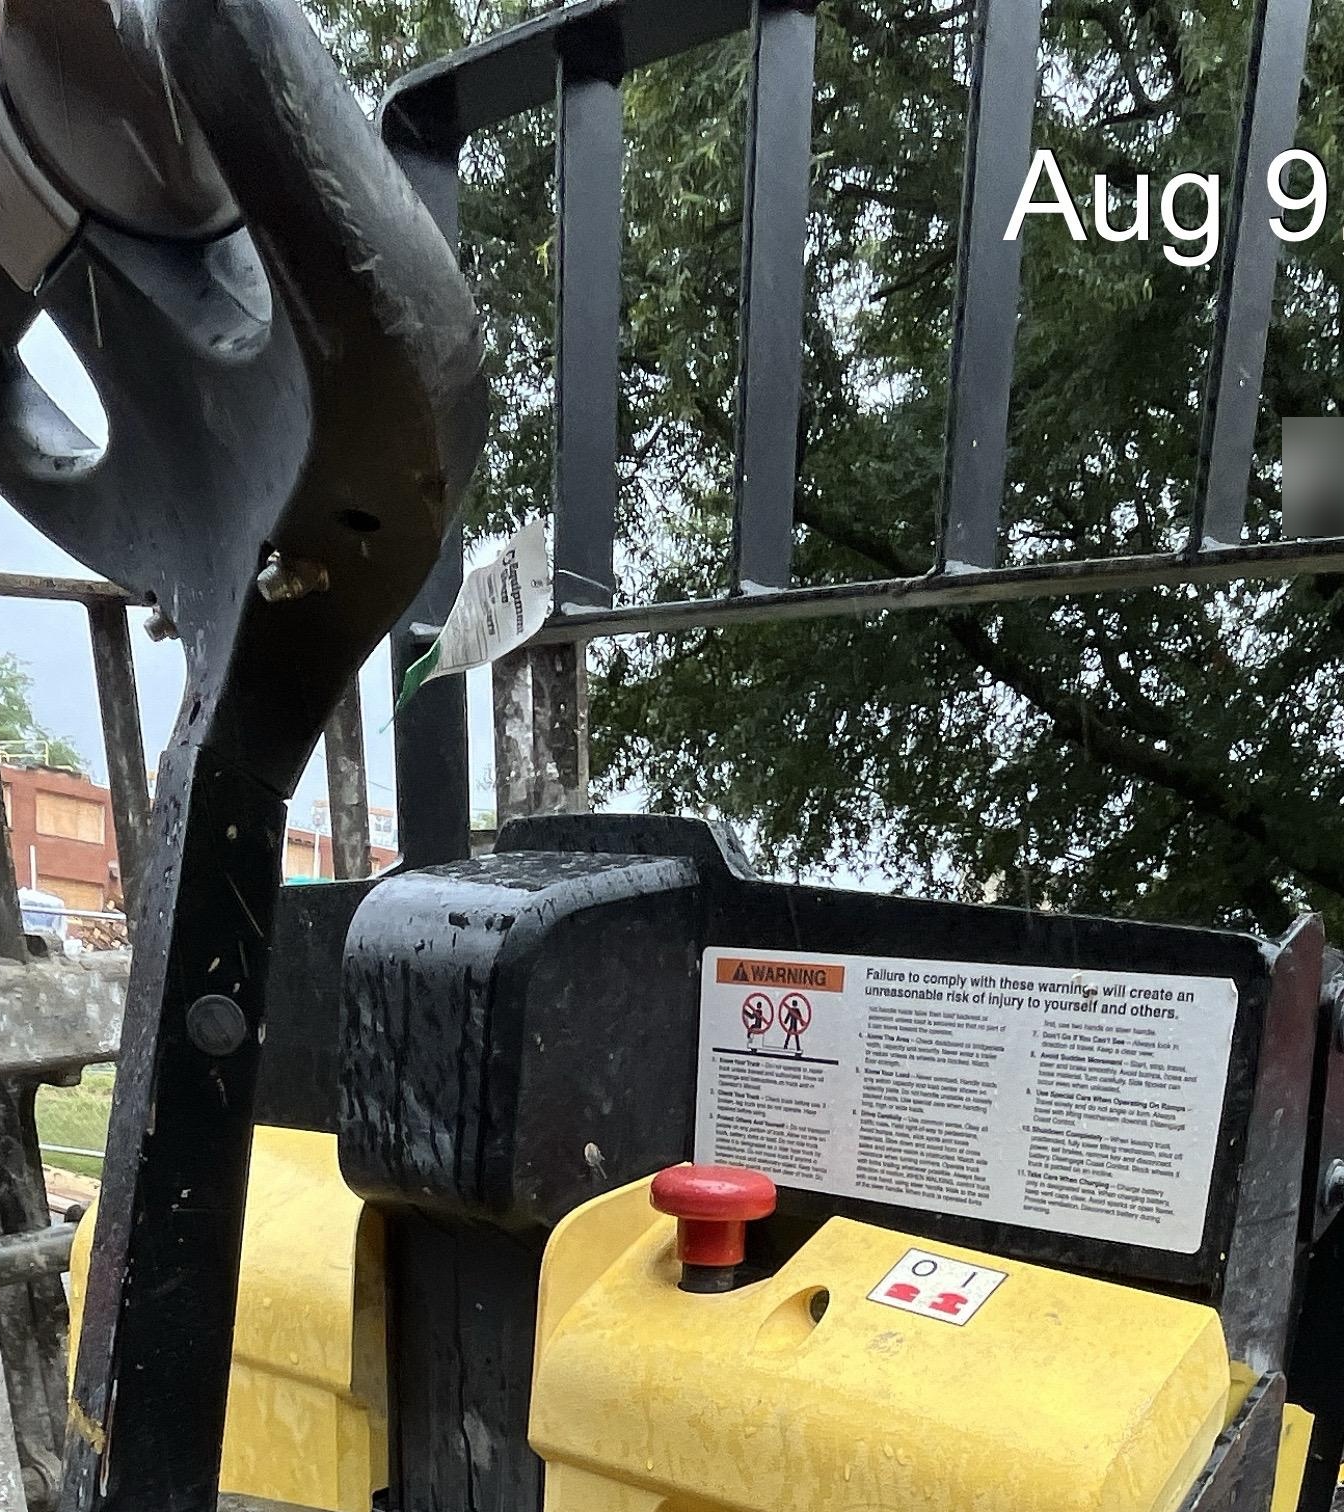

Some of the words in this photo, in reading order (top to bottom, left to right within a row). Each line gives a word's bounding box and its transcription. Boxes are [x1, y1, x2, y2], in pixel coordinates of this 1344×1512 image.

[751, 965, 826, 986] WARNING
[866, 968, 905, 982] Failure
[909, 971, 920, 982] to
[923, 973, 968, 989] comply
[970, 976, 996, 989] with
[1000, 978, 1034, 991] these
[1038, 981, 1099, 999] warnings
[1102, 984, 1126, 998] will
[1129, 986, 1173, 1001] create
[1177, 990, 1195, 1003] an
[865, 986, 943, 1001] unreasonable
[946, 990, 969, 1004] risk
[972, 992, 985, 1005] of
[988, 993, 1024, 1011] injury
[1028, 996, 1041, 1008] to
[1044, 999, 1099, 1014] yourself
[1101, 1002, 1126, 1015] and
[1130, 1005, 1179, 1020] others.
